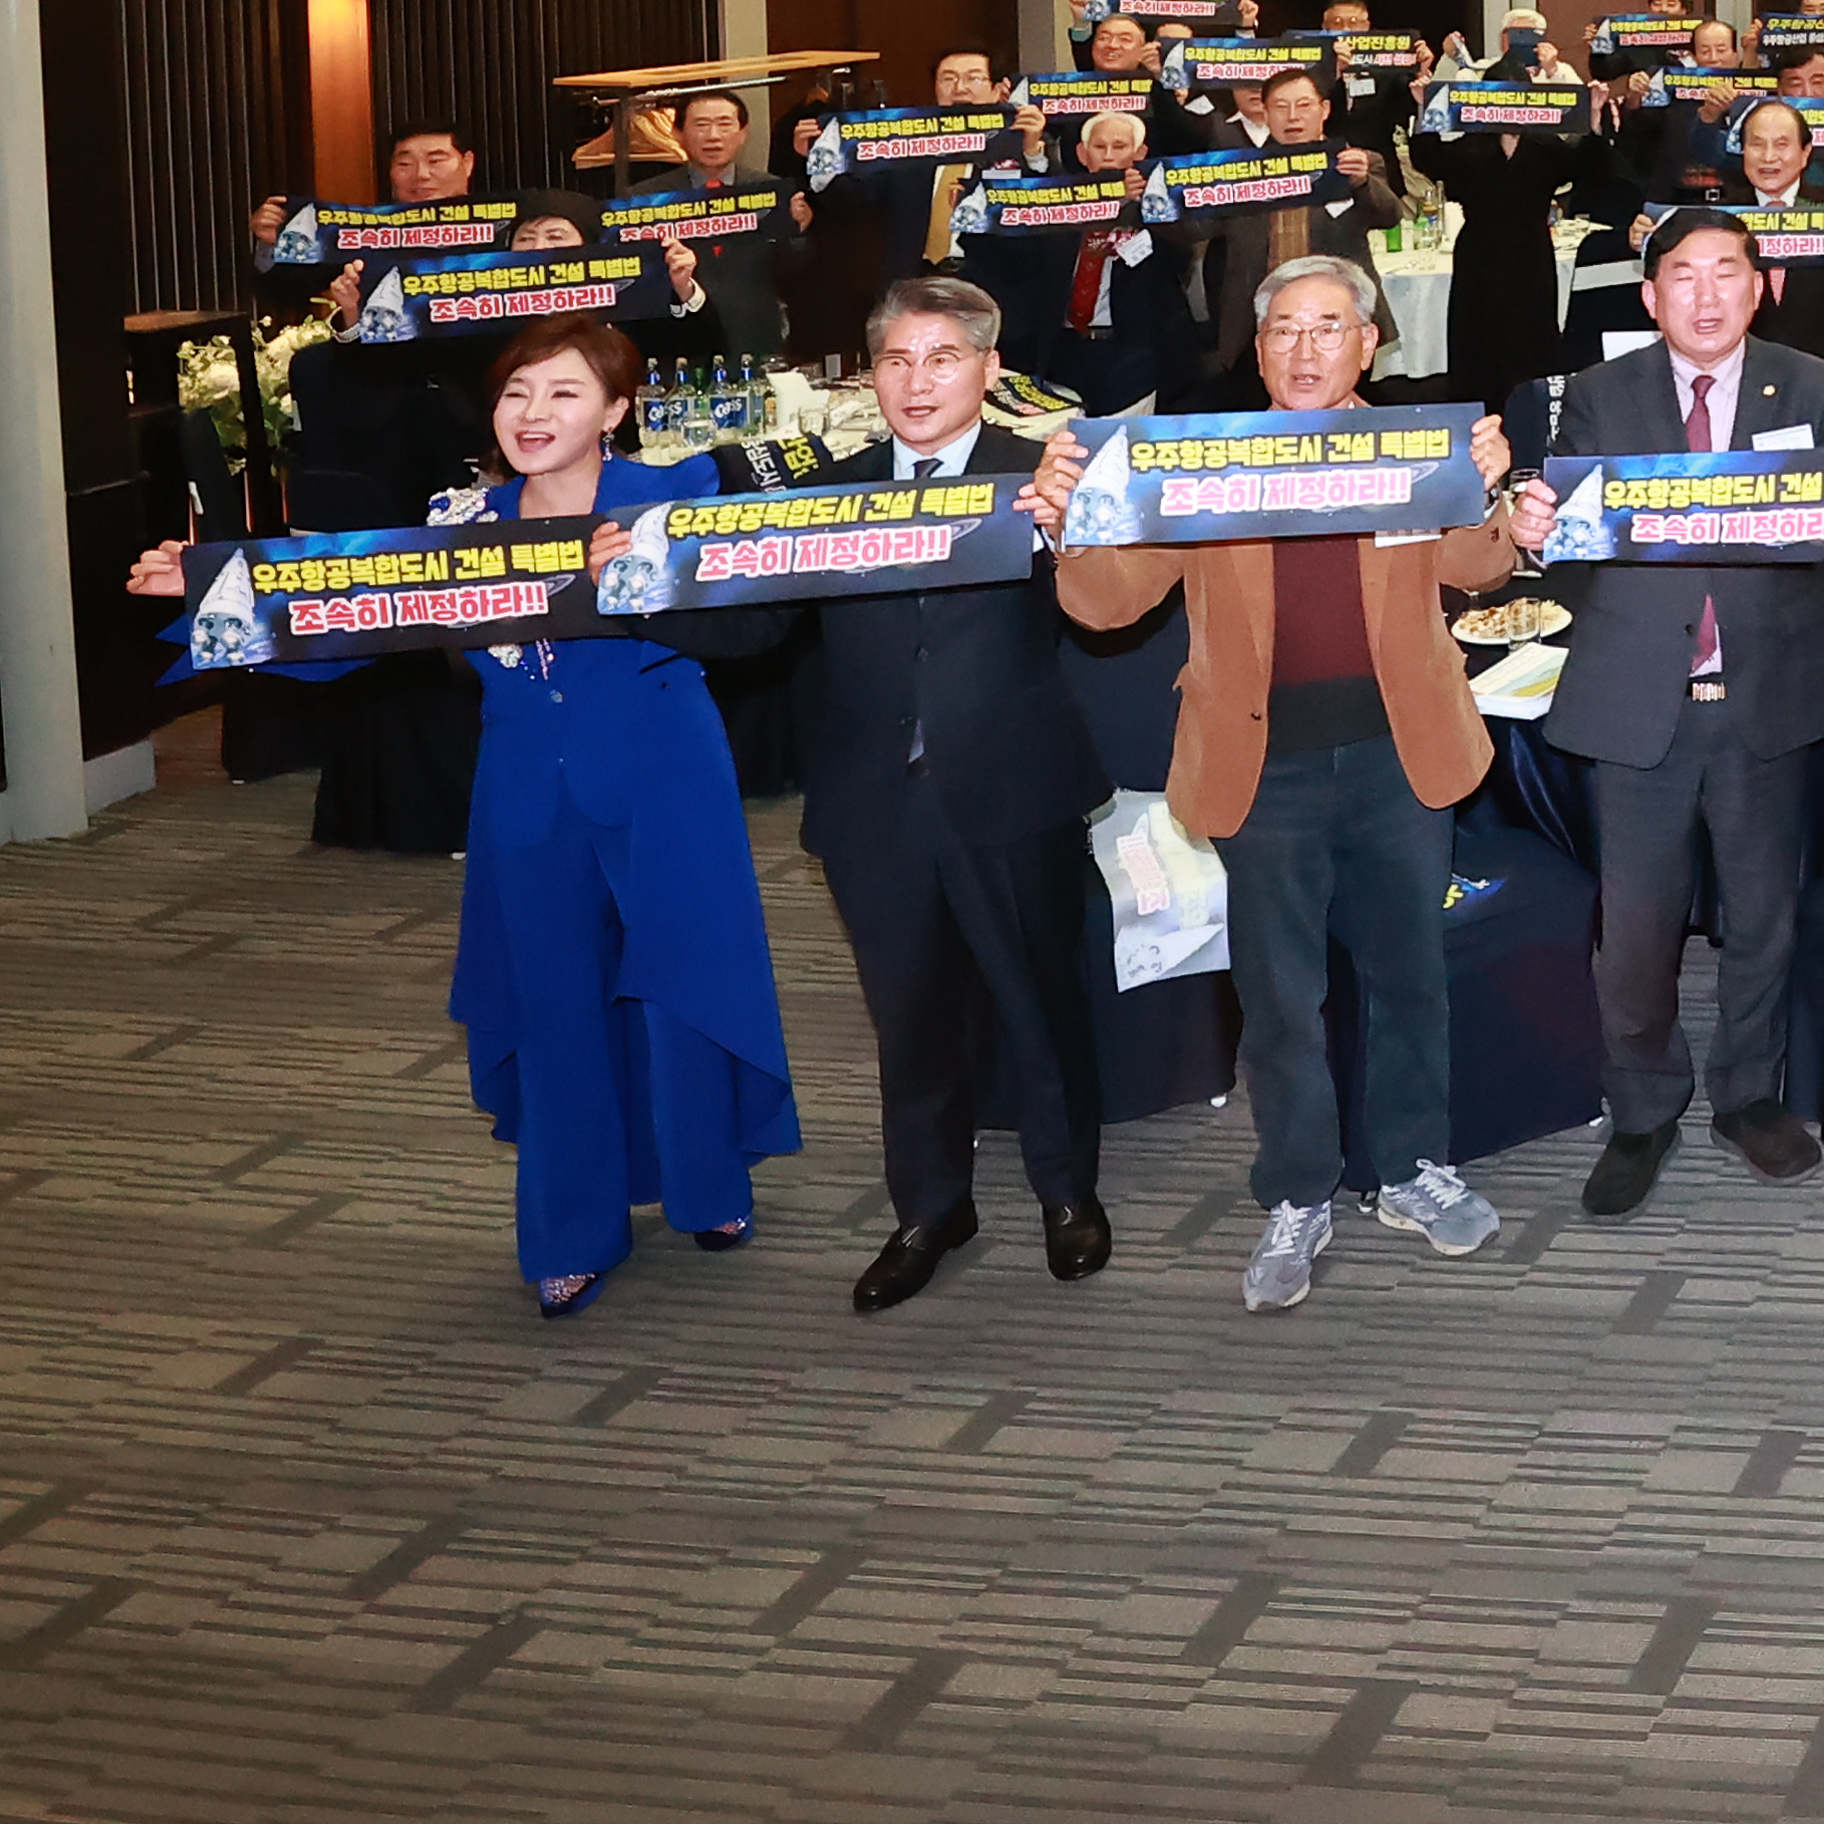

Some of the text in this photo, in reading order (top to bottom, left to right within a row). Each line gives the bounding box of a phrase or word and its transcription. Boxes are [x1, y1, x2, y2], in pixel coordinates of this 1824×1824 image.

[439, 205, 468, 221] 건설
[337, 223, 494, 249] 조속히 제정하라!!
[549, 261, 584, 284] 건설
[429, 283, 615, 322] 조속히 제정하라!!
[1133, 430, 1449, 466] 우주항공복합도시 건설 특별법
[1158, 461, 1422, 516] 조속히 제정하라!!
[1606, 477, 1771, 507] 우주항공복합도시
[1773, 474, 1823, 500] 건설
[667, 484, 993, 536] 우주항공복합도시 건설 특별법
[1630, 503, 1721, 544] 조속히
[252, 539, 584, 592] 우주항공복합도시 건설 특별법
[695, 520, 961, 581] 조속히 제정하라!!
[288, 580, 554, 635] 조속히 제정하라!!
